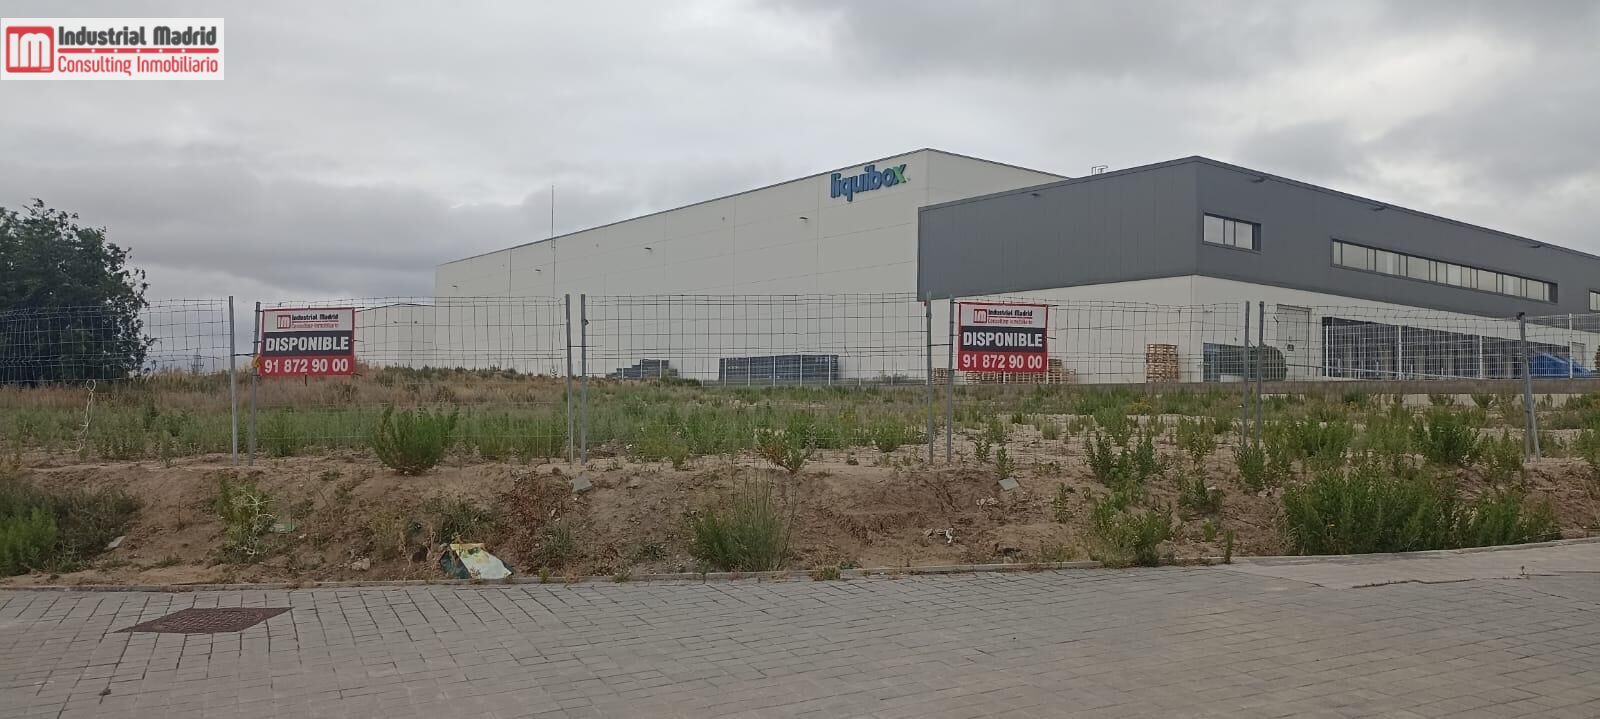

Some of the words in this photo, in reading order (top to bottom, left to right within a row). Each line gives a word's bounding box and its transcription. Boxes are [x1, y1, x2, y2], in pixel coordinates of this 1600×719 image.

[830, 163, 907, 202] liquibox
[265, 336, 349, 352] DISPONIBLE
[963, 331, 1043, 348] DISPONIBLE
[264, 359, 279, 373] 91
[284, 359, 308, 373] 872
[311, 358, 328, 373] 90
[332, 358, 349, 372] 00
[963, 354, 977, 368] 91
[982, 354, 1006, 369] 872
[1009, 355, 1024, 369] 90
[1027, 355, 1042, 369] 00
